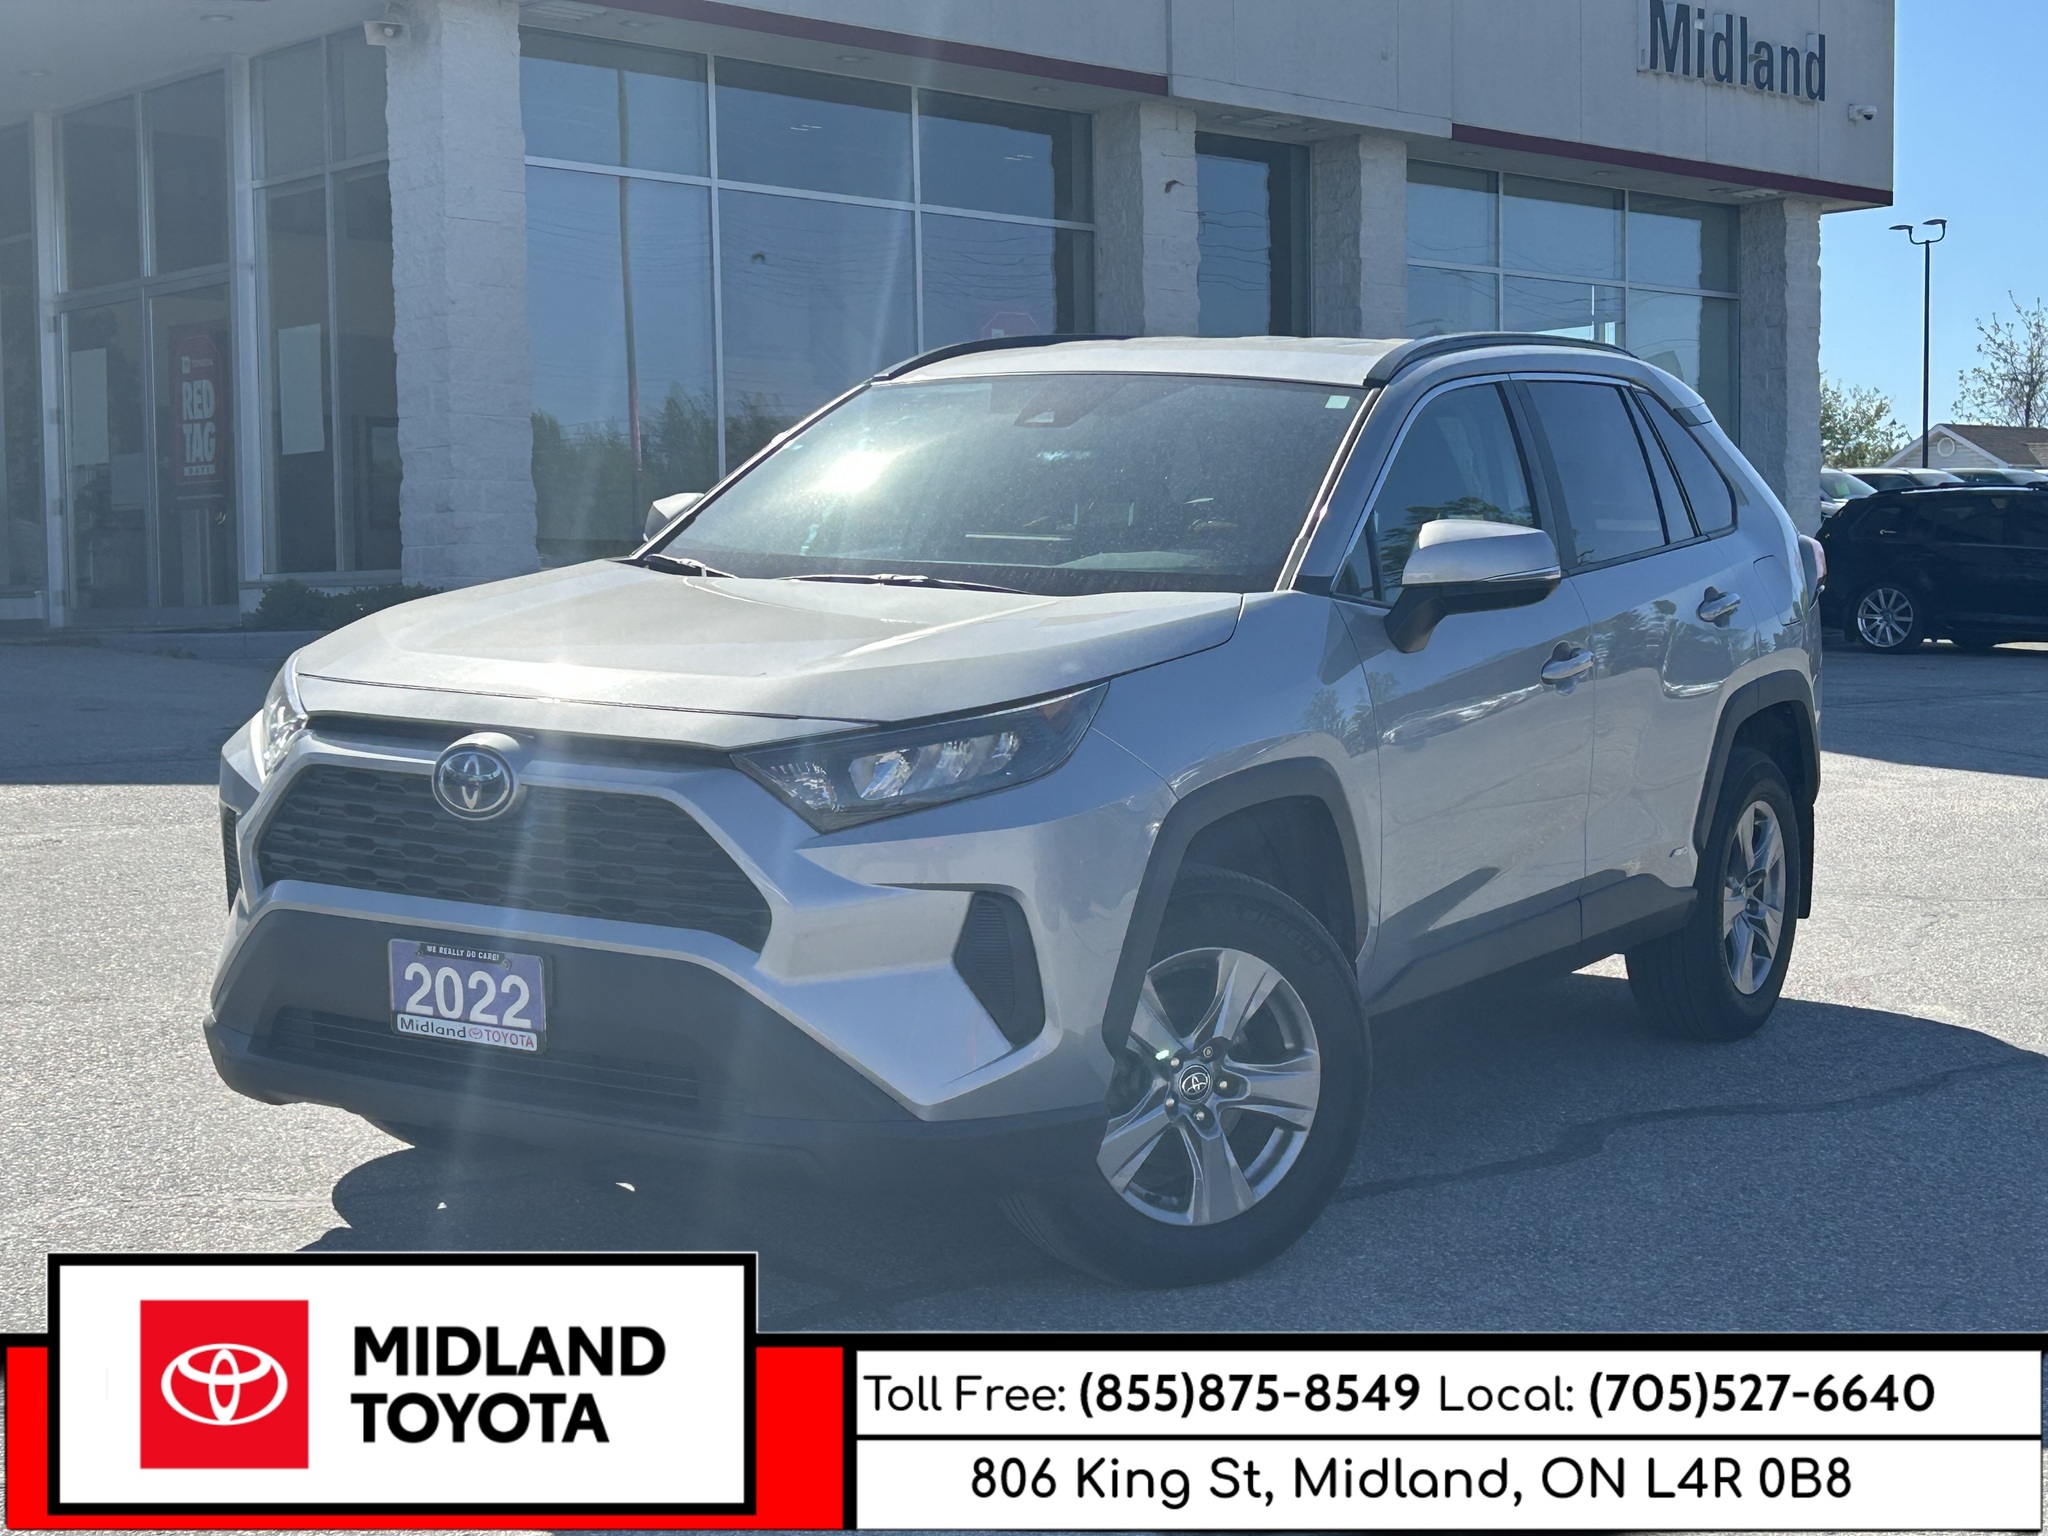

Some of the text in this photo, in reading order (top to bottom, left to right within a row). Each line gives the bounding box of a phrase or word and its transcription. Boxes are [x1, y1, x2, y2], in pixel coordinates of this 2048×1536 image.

[1649, 0, 1826, 101] Midland
[182, 379, 215, 420] RED
[183, 421, 216, 463] TAG
[438, 946, 464, 957] REALLY
[404, 962, 532, 1029] 2022
[400, 1017, 535, 1048] Midland TOYOTA
